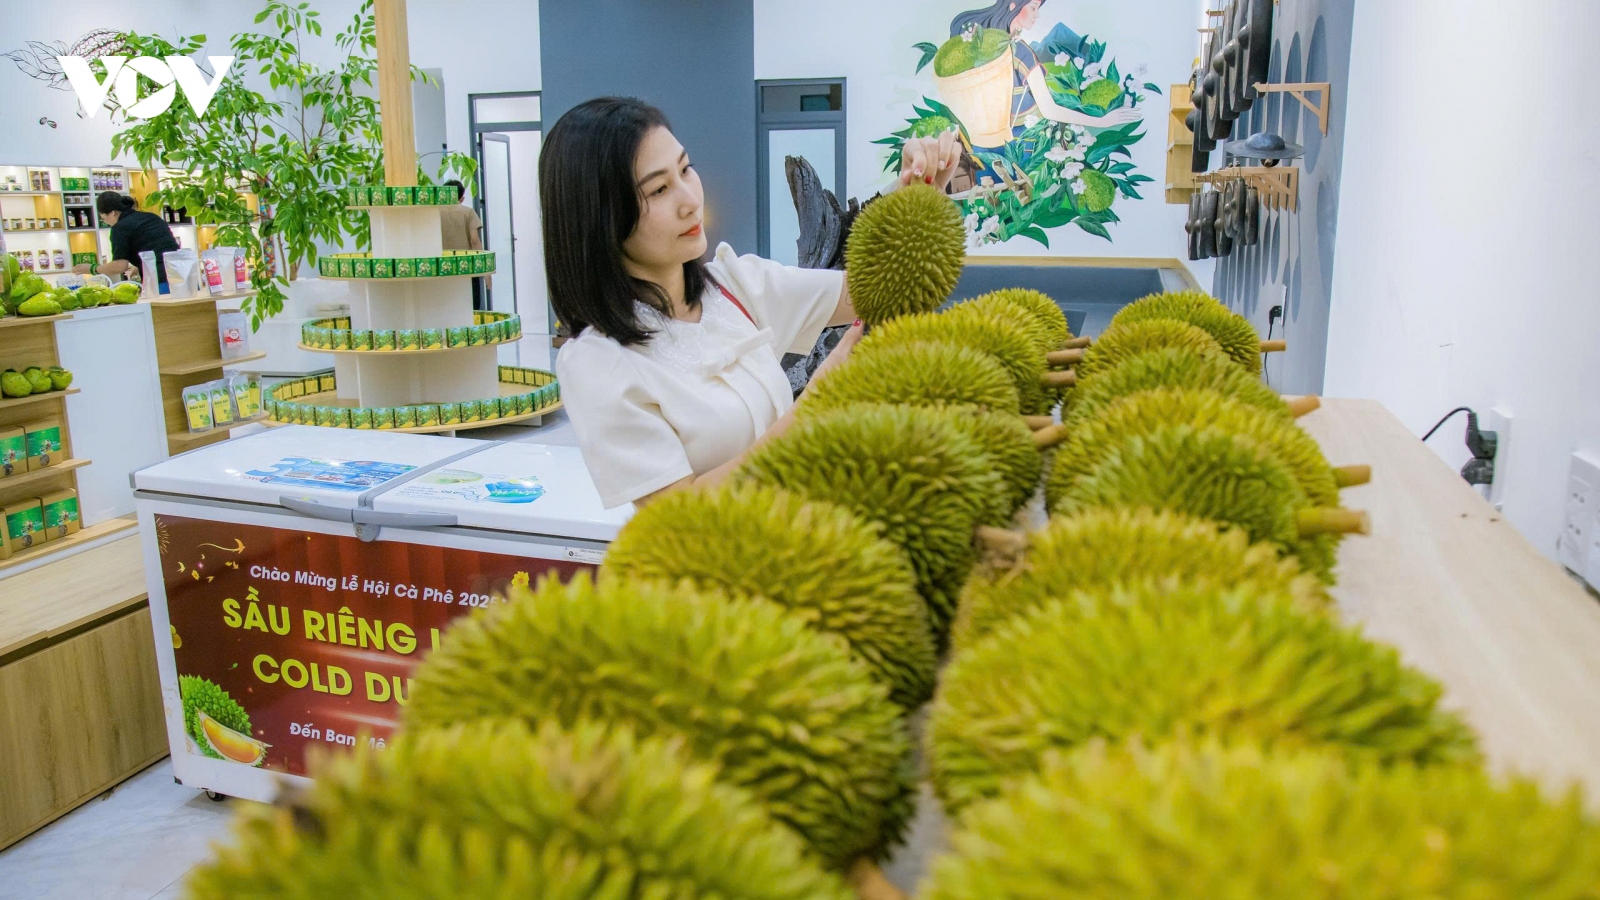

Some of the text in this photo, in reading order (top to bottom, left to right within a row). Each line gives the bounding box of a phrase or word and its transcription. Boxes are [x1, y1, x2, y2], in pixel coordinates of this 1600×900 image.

[250, 565, 290, 582] Chào
[294, 570, 337, 592] Mừng
[341, 574, 359, 591] Lễ
[363, 579, 390, 598] Hội
[394, 583, 418, 600] Cà
[423, 587, 454, 604] Phê
[222, 585, 291, 636] SẦU
[303, 606, 417, 655] RIÊNG
[252, 653, 353, 696] COLD
[289, 722, 321, 740] Đến
[325, 728, 356, 747] Ban
